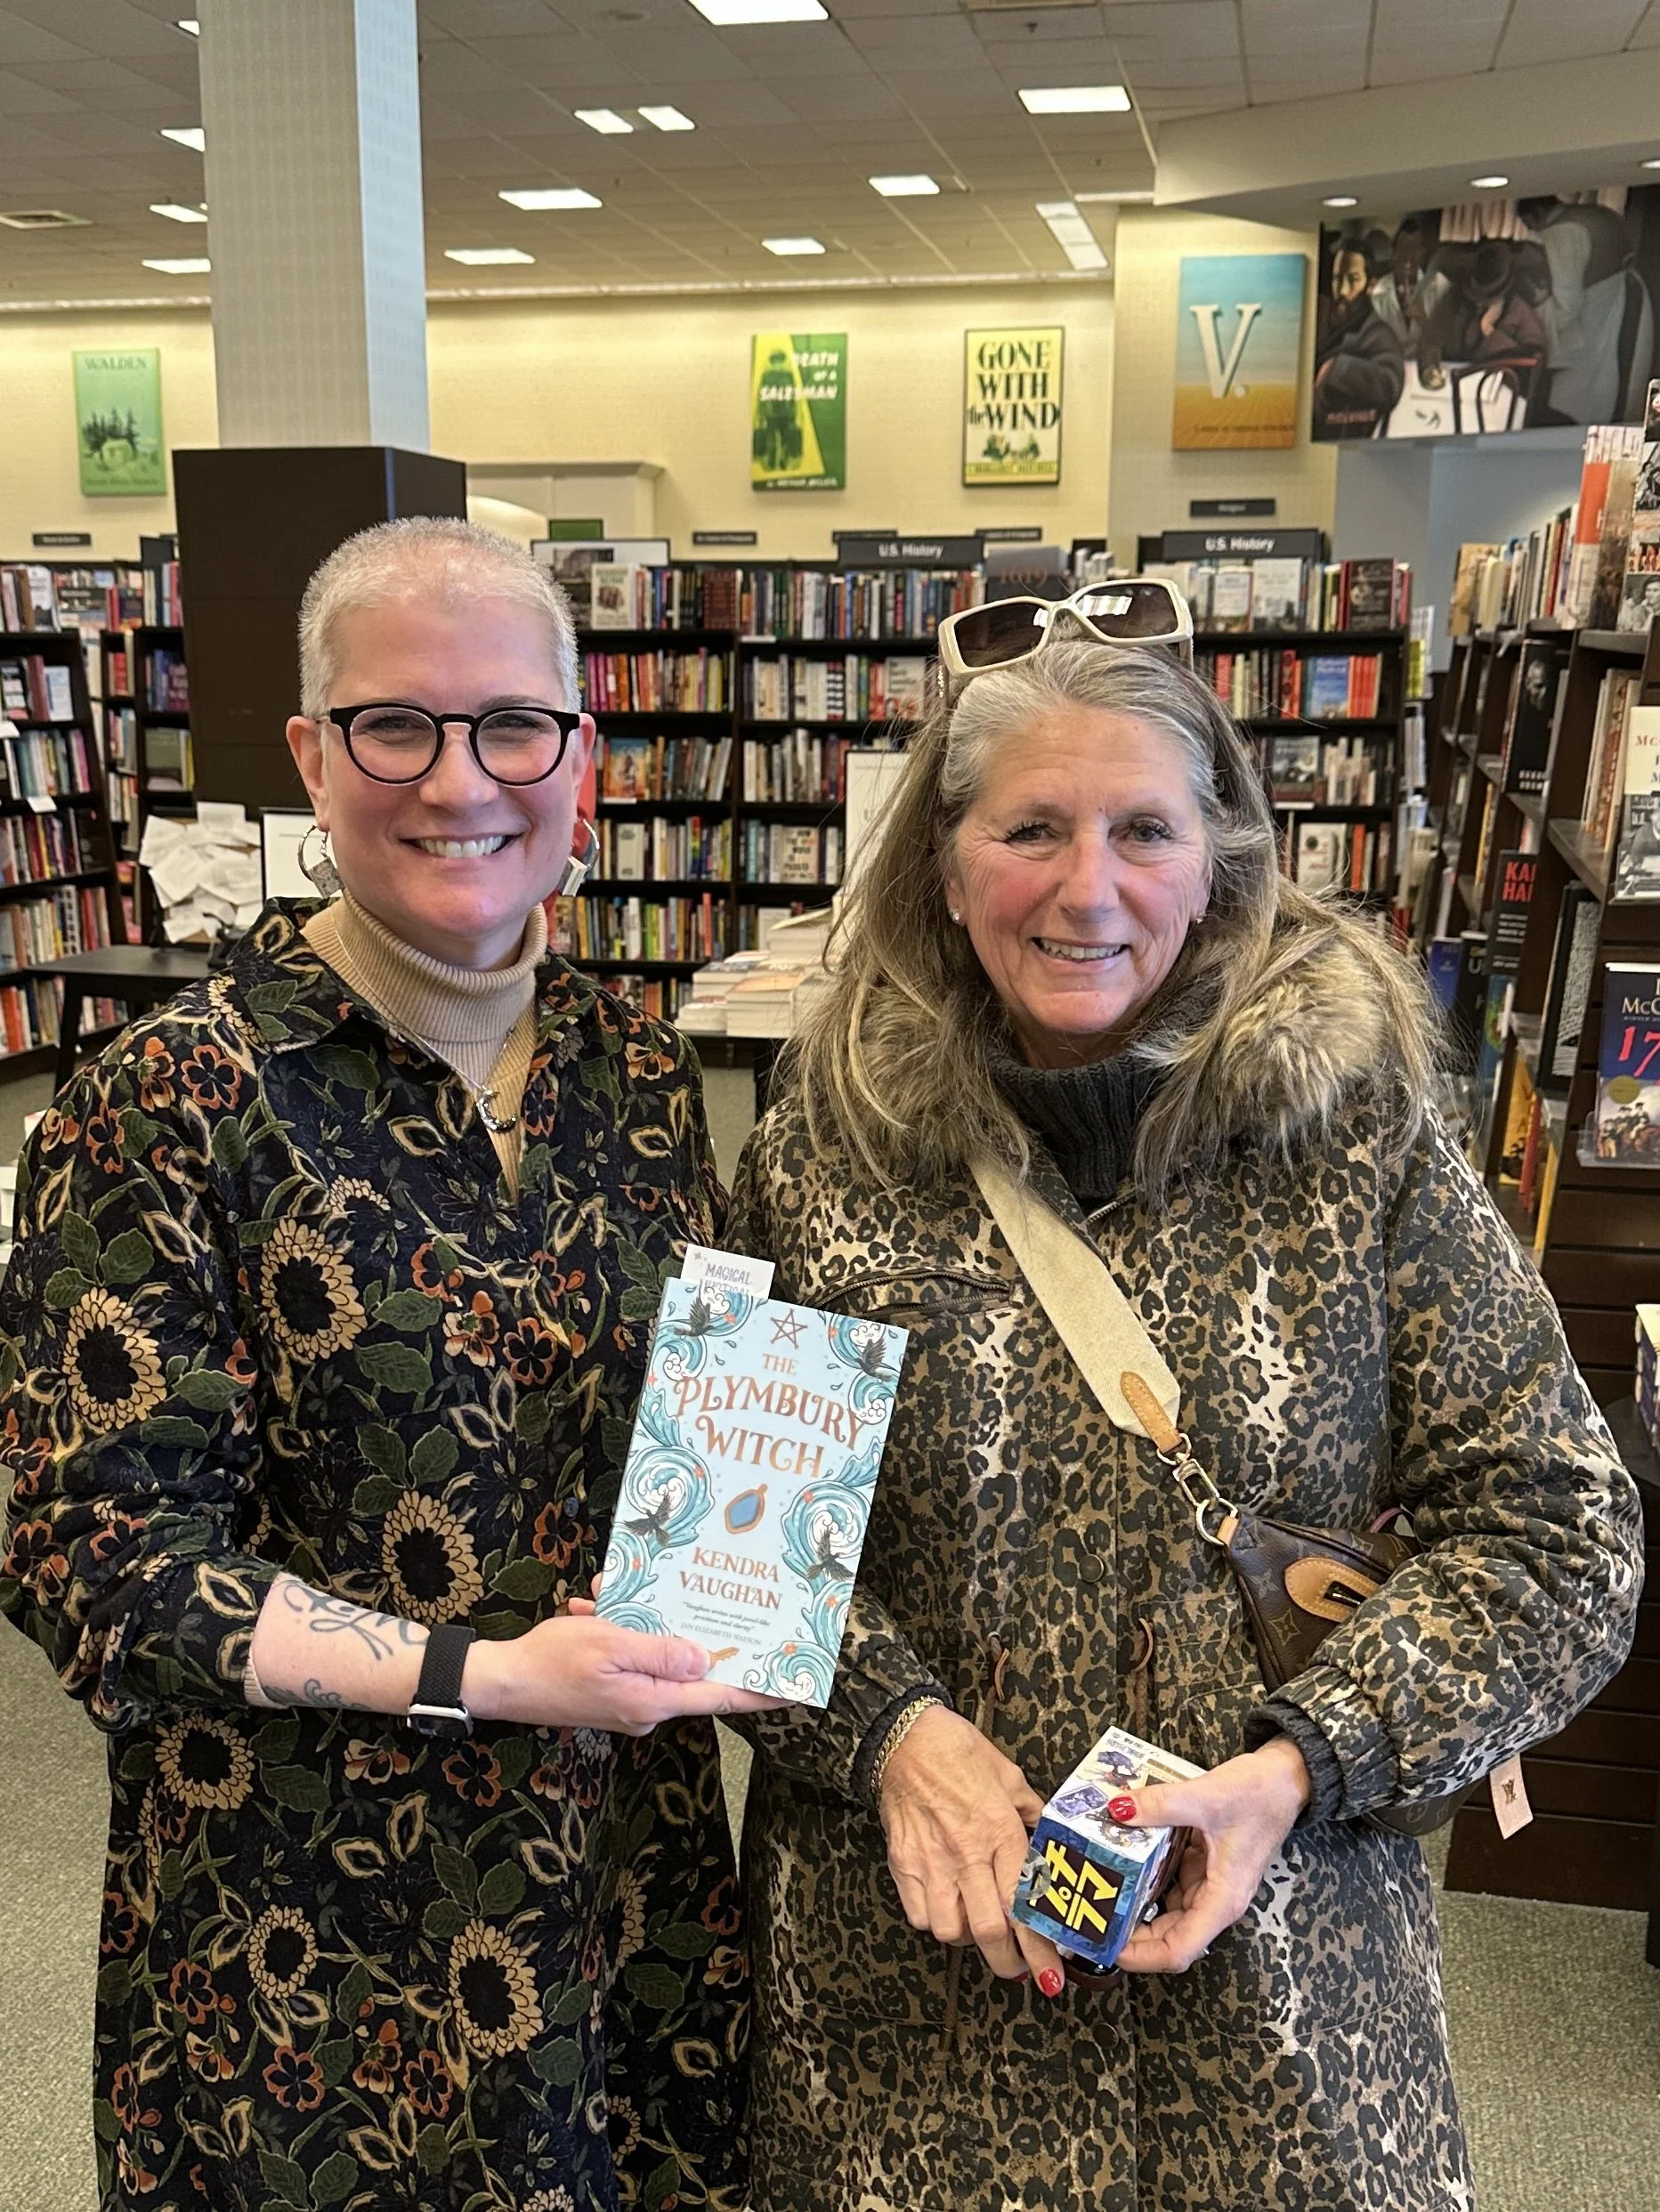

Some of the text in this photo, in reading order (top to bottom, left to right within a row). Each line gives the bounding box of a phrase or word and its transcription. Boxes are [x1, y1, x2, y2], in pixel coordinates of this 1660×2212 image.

[85, 355, 148, 370] WALDEN
[792, 352, 838, 368] DEATH
[978, 341, 1052, 370] GONE
[759, 385, 838, 401] SALESMAN
[976, 372, 1049, 401] WITH
[982, 402, 1060, 431] WIND
[879, 541, 943, 562] U.S. History
[1205, 536, 1275, 554] U.S. History
[705, 1262, 751, 1284] MAGICAL
[761, 1352, 798, 1376] THE
[673, 1374, 869, 1451] PLYMBURY
[695, 1414, 828, 1479] WITCH
[692, 1546, 780, 1584] KENDRA
[679, 1570, 783, 1611] VAUGHAN
[694, 1623, 733, 1640] ELIZABETH
